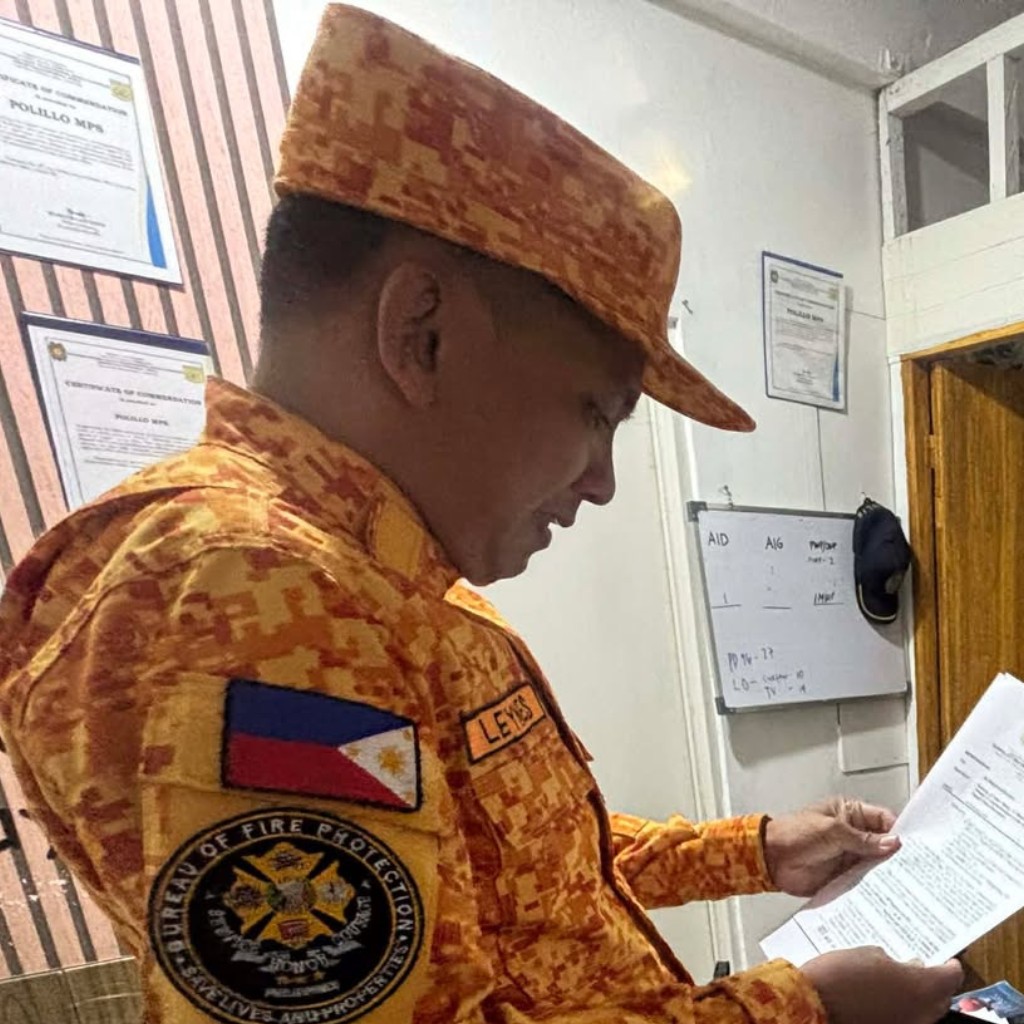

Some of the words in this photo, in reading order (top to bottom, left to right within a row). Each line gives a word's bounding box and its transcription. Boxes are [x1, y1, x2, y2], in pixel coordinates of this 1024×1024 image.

[9, 99, 70, 124] POLILLO
[74, 117, 104, 133] MPS
[162, 863, 199, 952] BUREAU
[199, 834, 230, 858] OF
[242, 819, 303, 838] FIRE
[316, 822, 414, 932] PROTECTION
[180, 965, 223, 1001] SAVE
[221, 995, 273, 1023] LIVES
